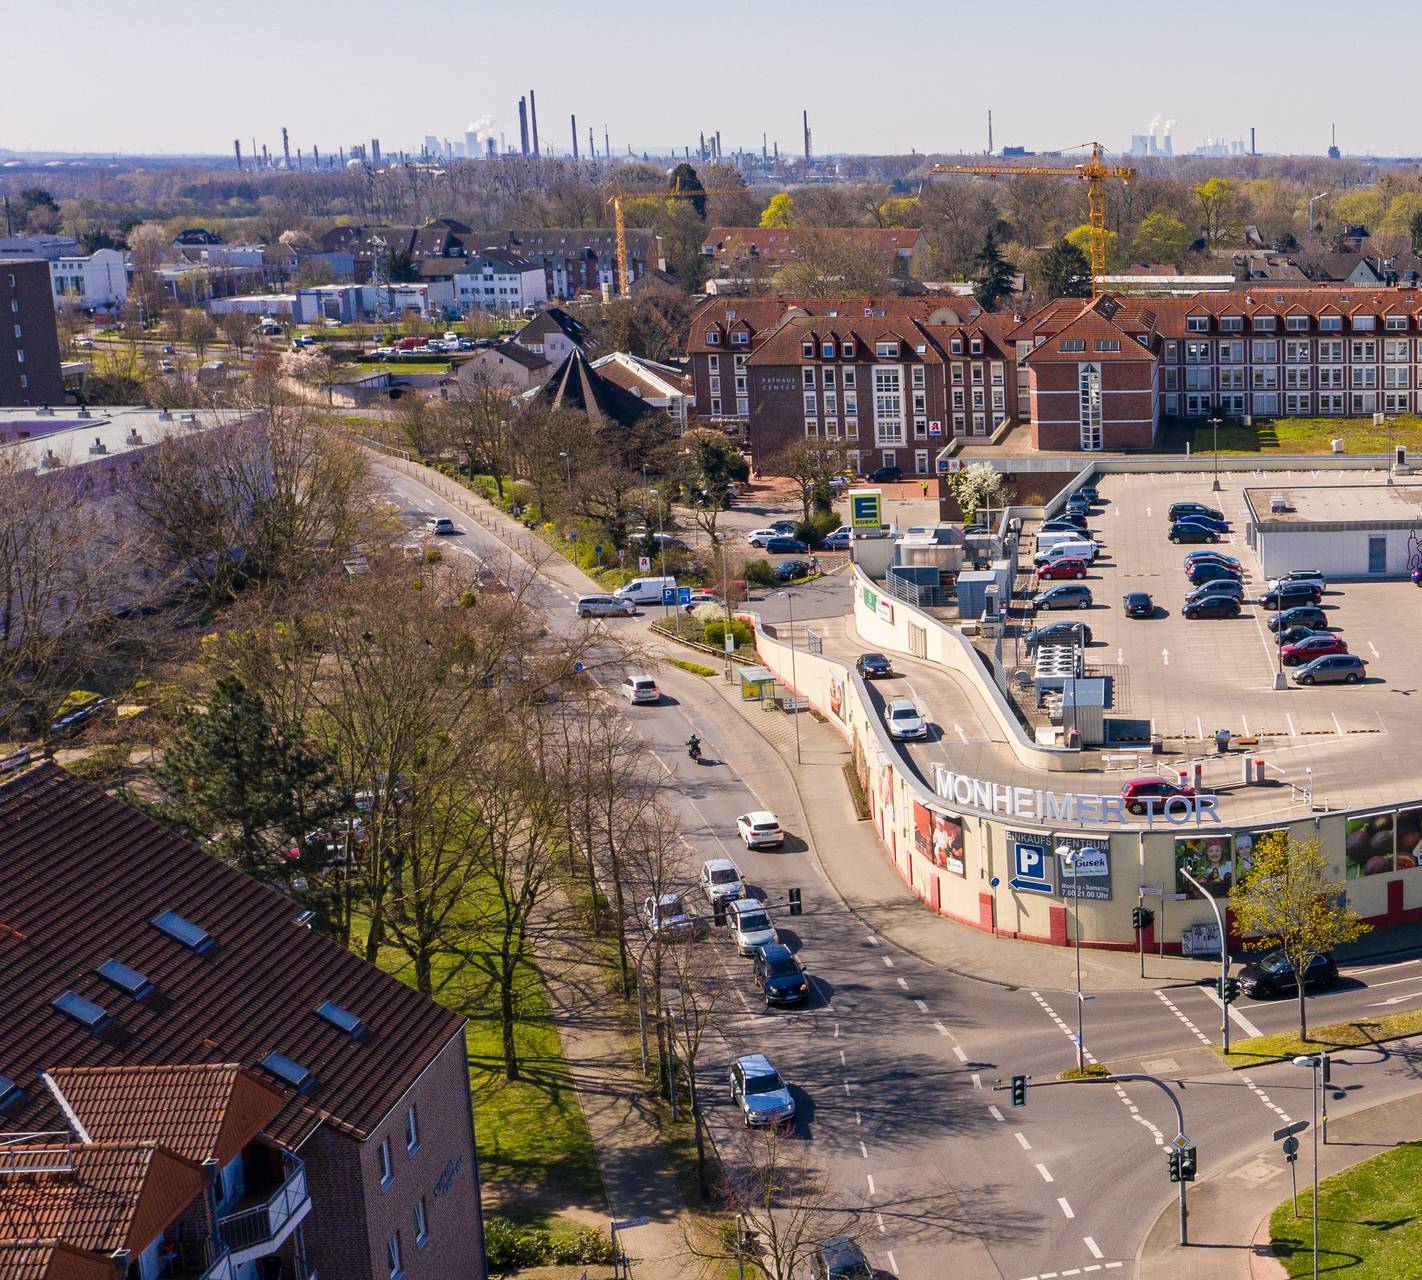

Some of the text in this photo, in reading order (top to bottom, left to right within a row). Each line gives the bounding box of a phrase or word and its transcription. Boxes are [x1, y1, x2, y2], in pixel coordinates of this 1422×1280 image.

[665, 589, 672, 599] P
[935, 767, 1223, 827] MONHEIMER TOR
[1006, 831, 1052, 847] EINKAUFS
[1059, 838, 1109, 851] ZENTRUM
[1020, 848, 1040, 873] P
[1075, 858, 1106, 868] Gusek
[1096, 891, 1109, 899] Uhr
